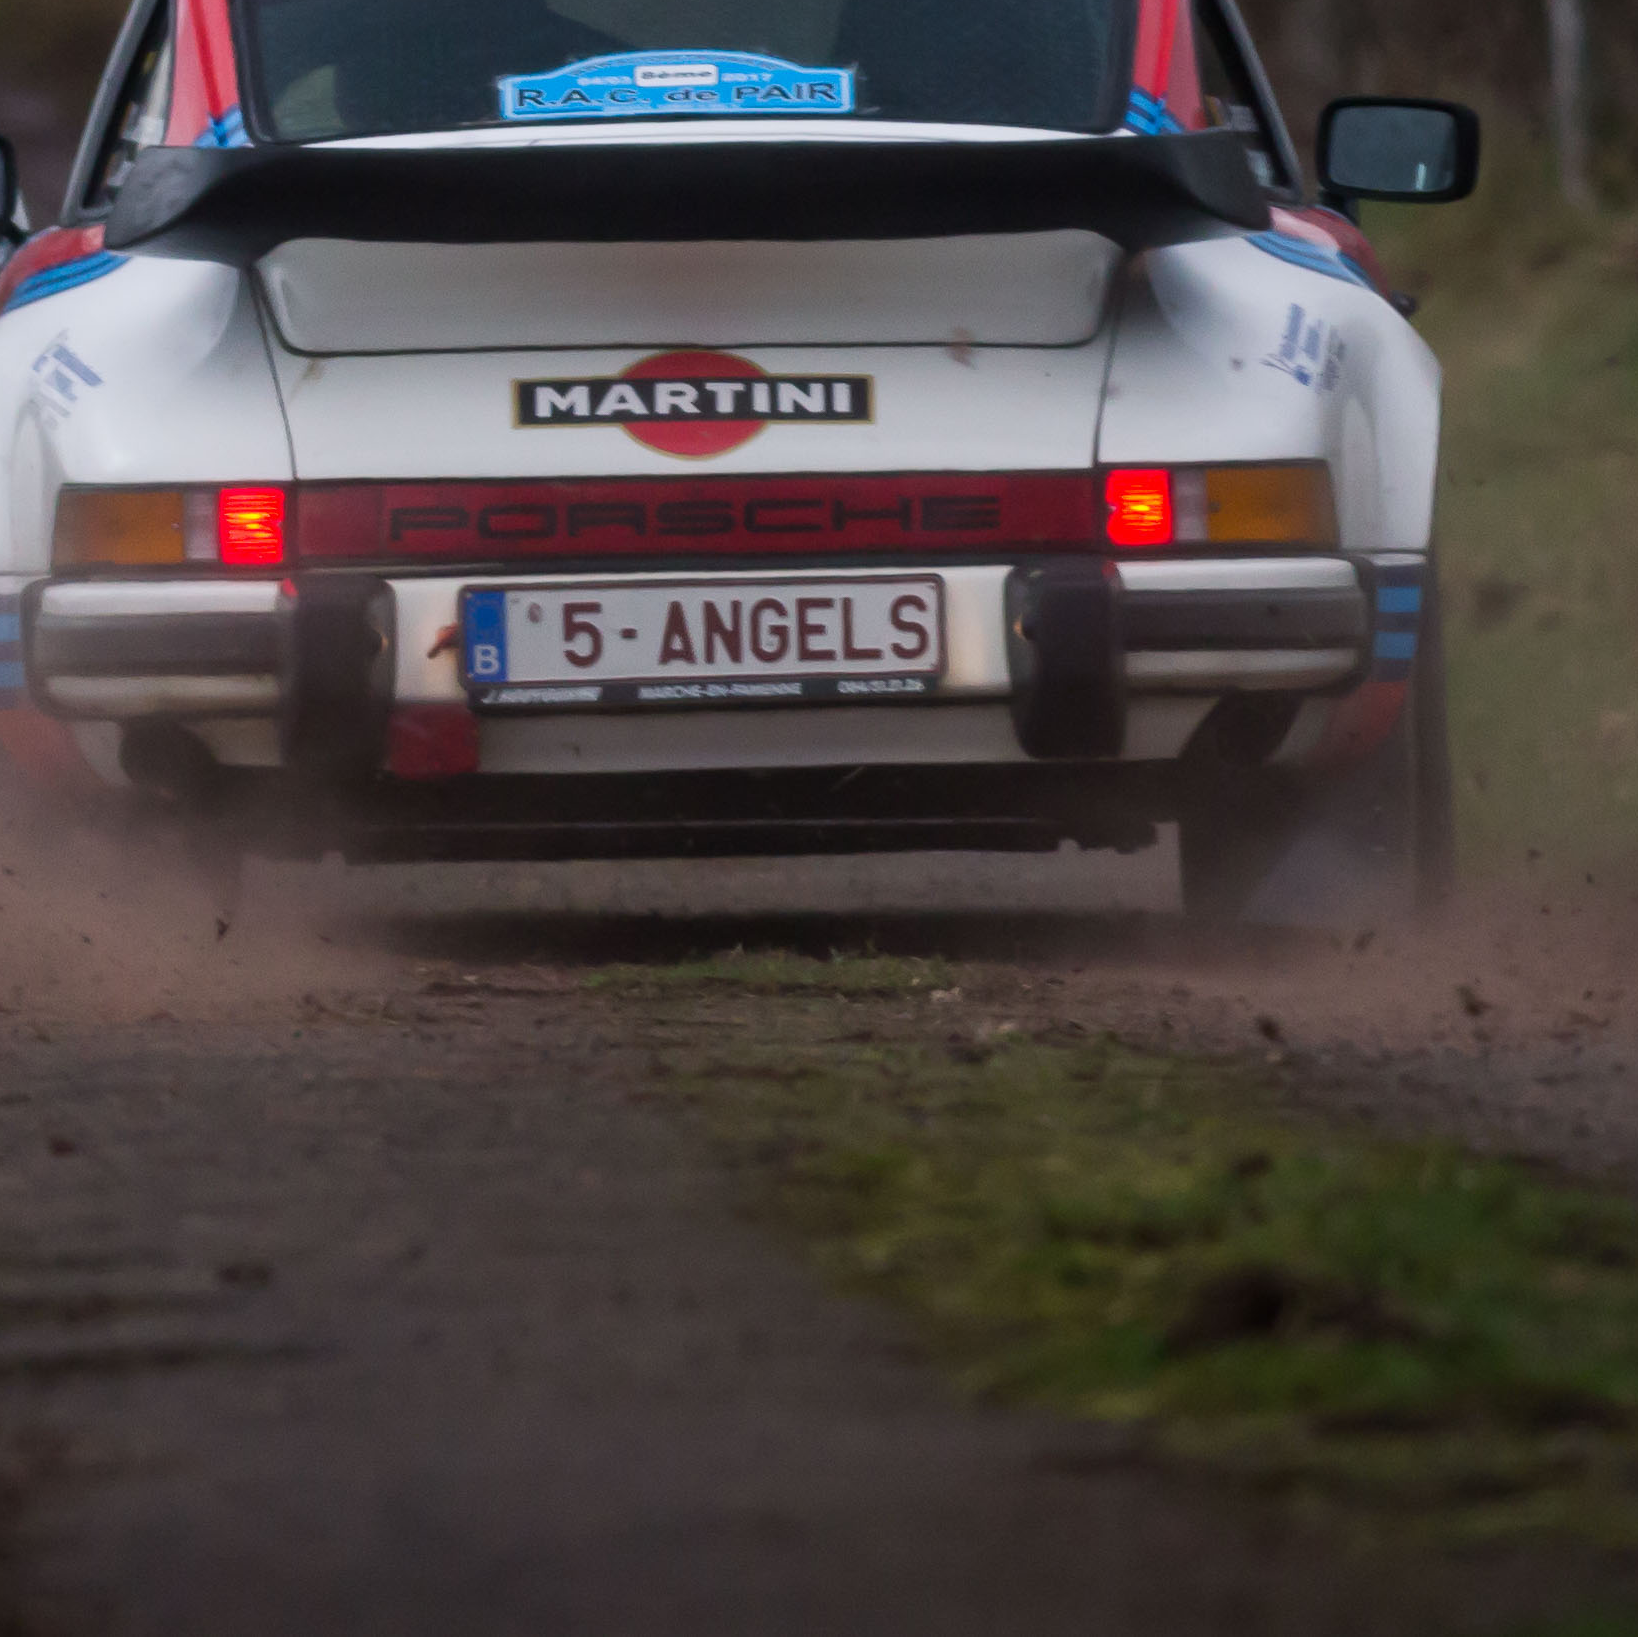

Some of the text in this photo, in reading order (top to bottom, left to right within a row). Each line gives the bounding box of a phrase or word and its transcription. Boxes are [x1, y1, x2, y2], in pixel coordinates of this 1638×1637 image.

[516, 82, 839, 107] R.A.C. de PAIR
[533, 381, 852, 418] MARTINI
[388, 495, 1001, 542] PORSCHE
[473, 643, 501, 675] B
